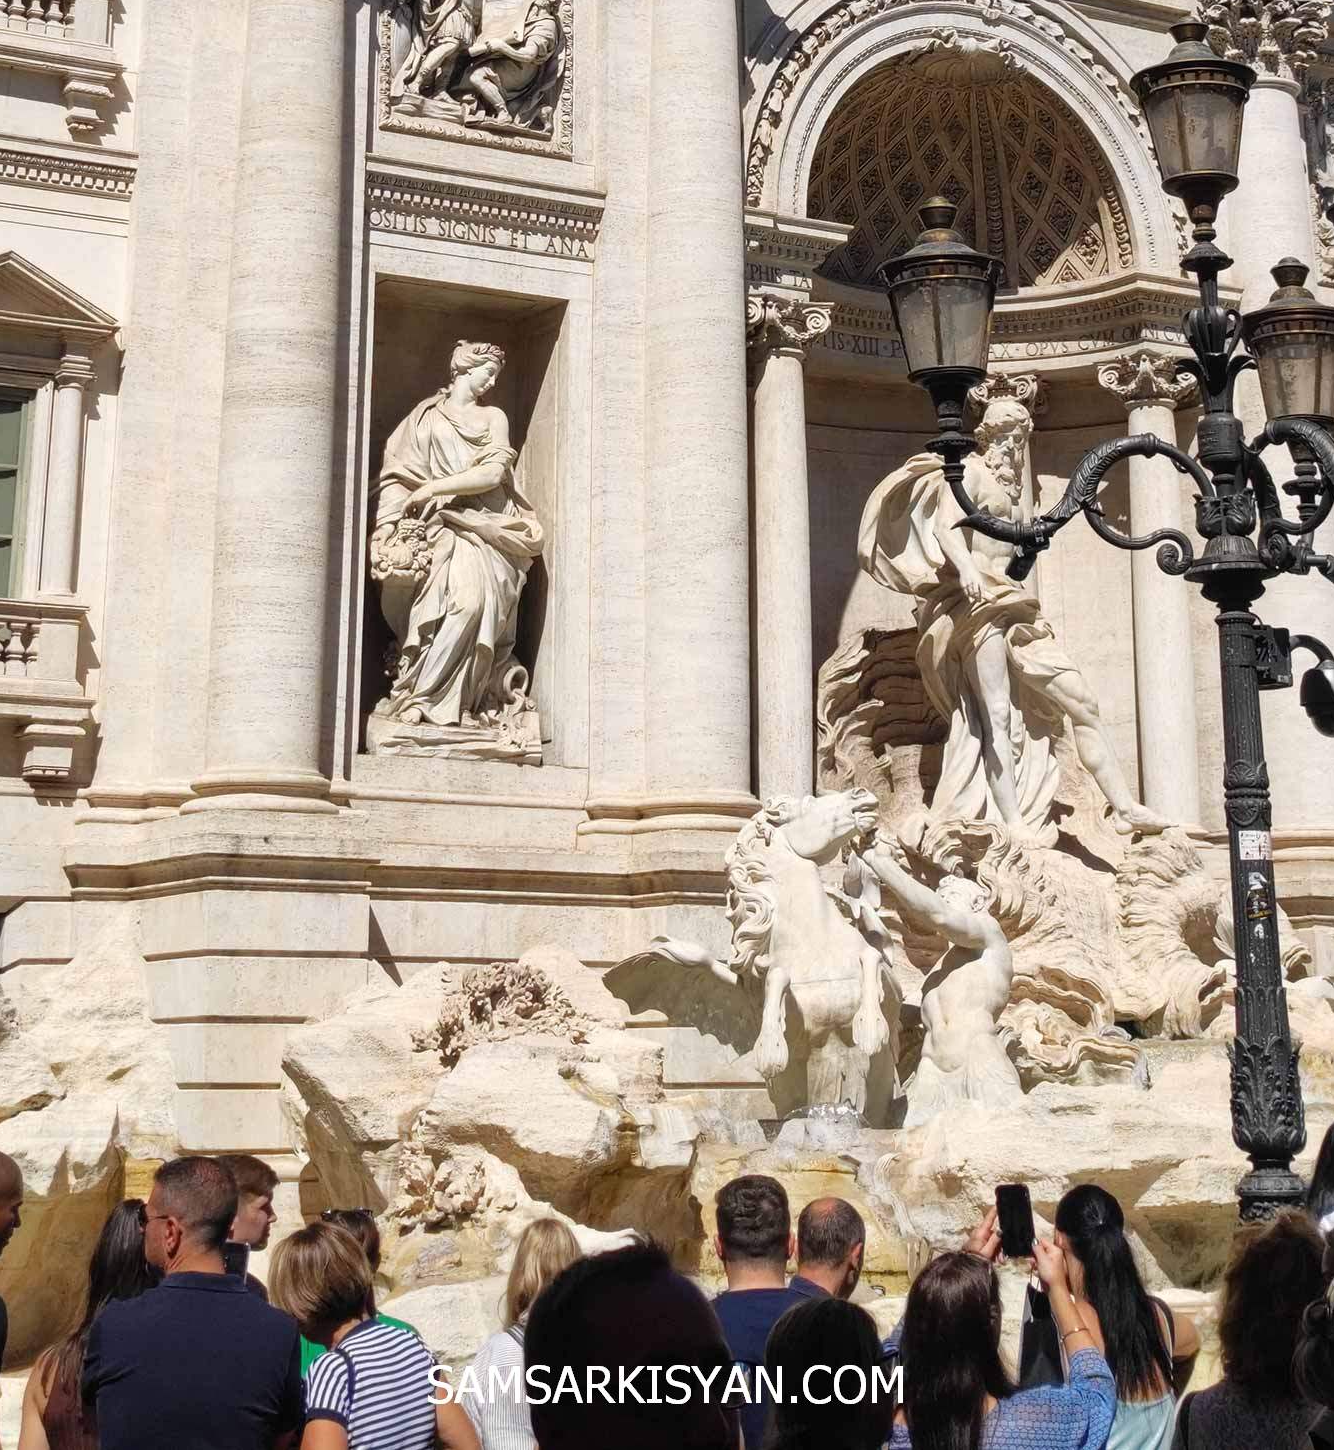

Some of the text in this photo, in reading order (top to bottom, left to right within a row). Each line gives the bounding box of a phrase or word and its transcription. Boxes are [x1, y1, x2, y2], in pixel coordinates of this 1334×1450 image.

[438, 218, 496, 244] SIGNIS
[510, 228, 531, 249] ET
[545, 234, 589, 258] ANA
[747, 263, 782, 283] PHIS
[1025, 339, 1068, 357] OPVS
[1077, 332, 1117, 350] CVM
